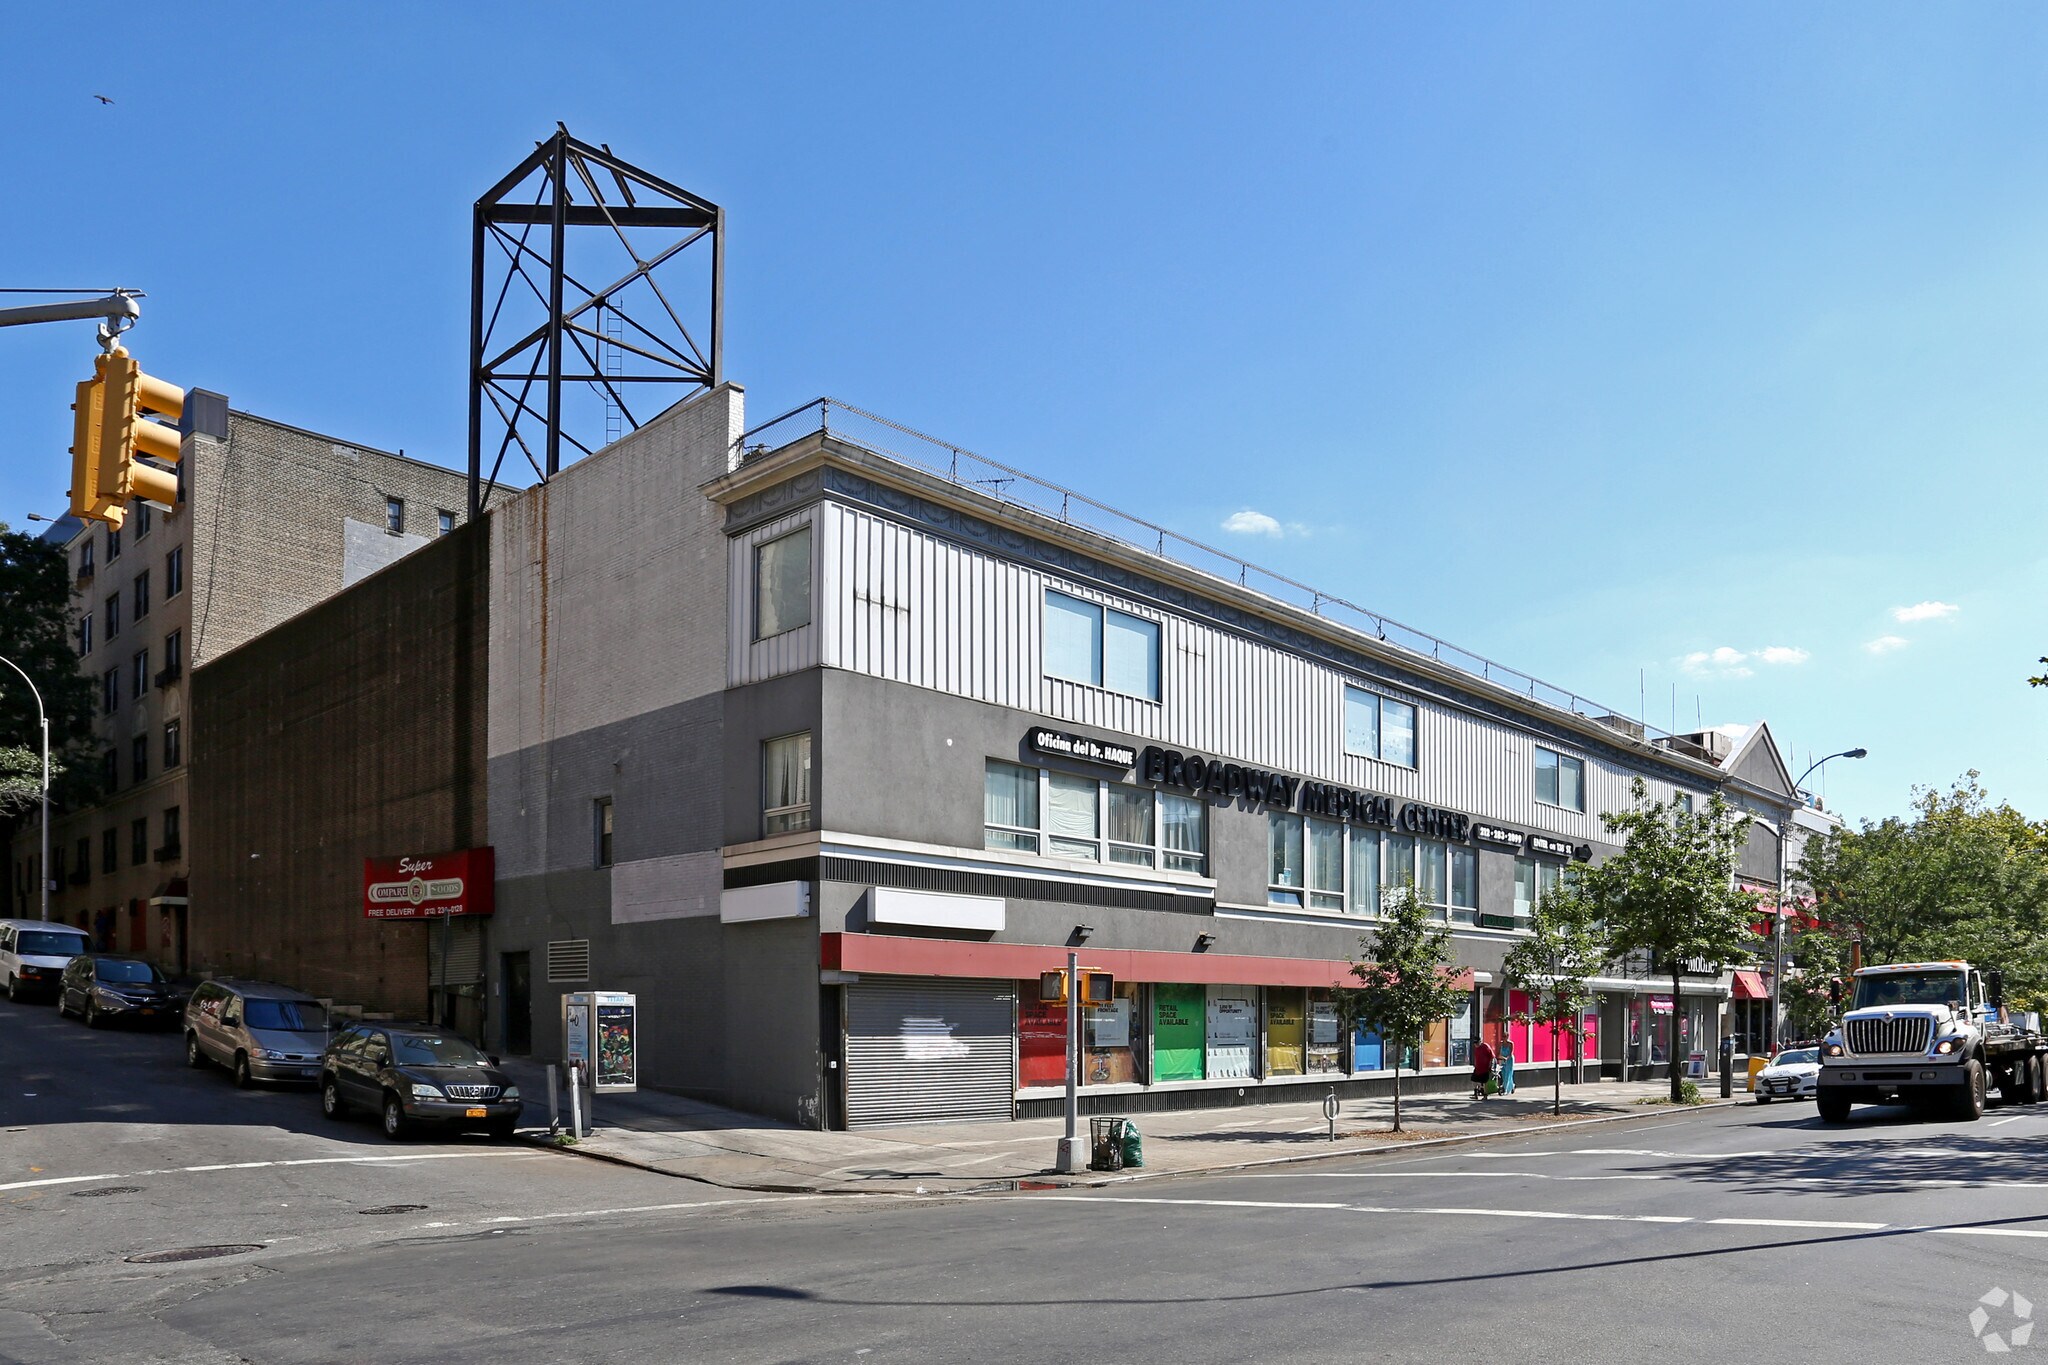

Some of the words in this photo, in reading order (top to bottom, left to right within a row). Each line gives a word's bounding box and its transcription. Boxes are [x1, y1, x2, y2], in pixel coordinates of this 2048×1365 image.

[1037, 732, 1071, 752] Oficina
[1073, 739, 1089, 755] del
[1090, 743, 1104, 759] Dr.
[1104, 746, 1133, 765] HAQUE
[1145, 745, 1301, 808] BROADWAY
[1303, 780, 1397, 828] MEDICAL
[1402, 801, 1471, 843] CENTER
[1533, 837, 1549, 849] ENTER
[399, 857, 433, 875] Super
[370, 884, 408, 900] COMPARE
[368, 908, 384, 917] FREE
[386, 907, 415, 916] DELIVERY
[1158, 1004, 1178, 1012] RETAIL
[1025, 1011, 1046, 1019] SPACE
[1158, 1011, 1177, 1019] SPACE
[1024, 1018, 1061, 1027] AVAILABLE
[1158, 1018, 1189, 1026] AVAILABLE
[1270, 1018, 1295, 1026] AVAILABLE
